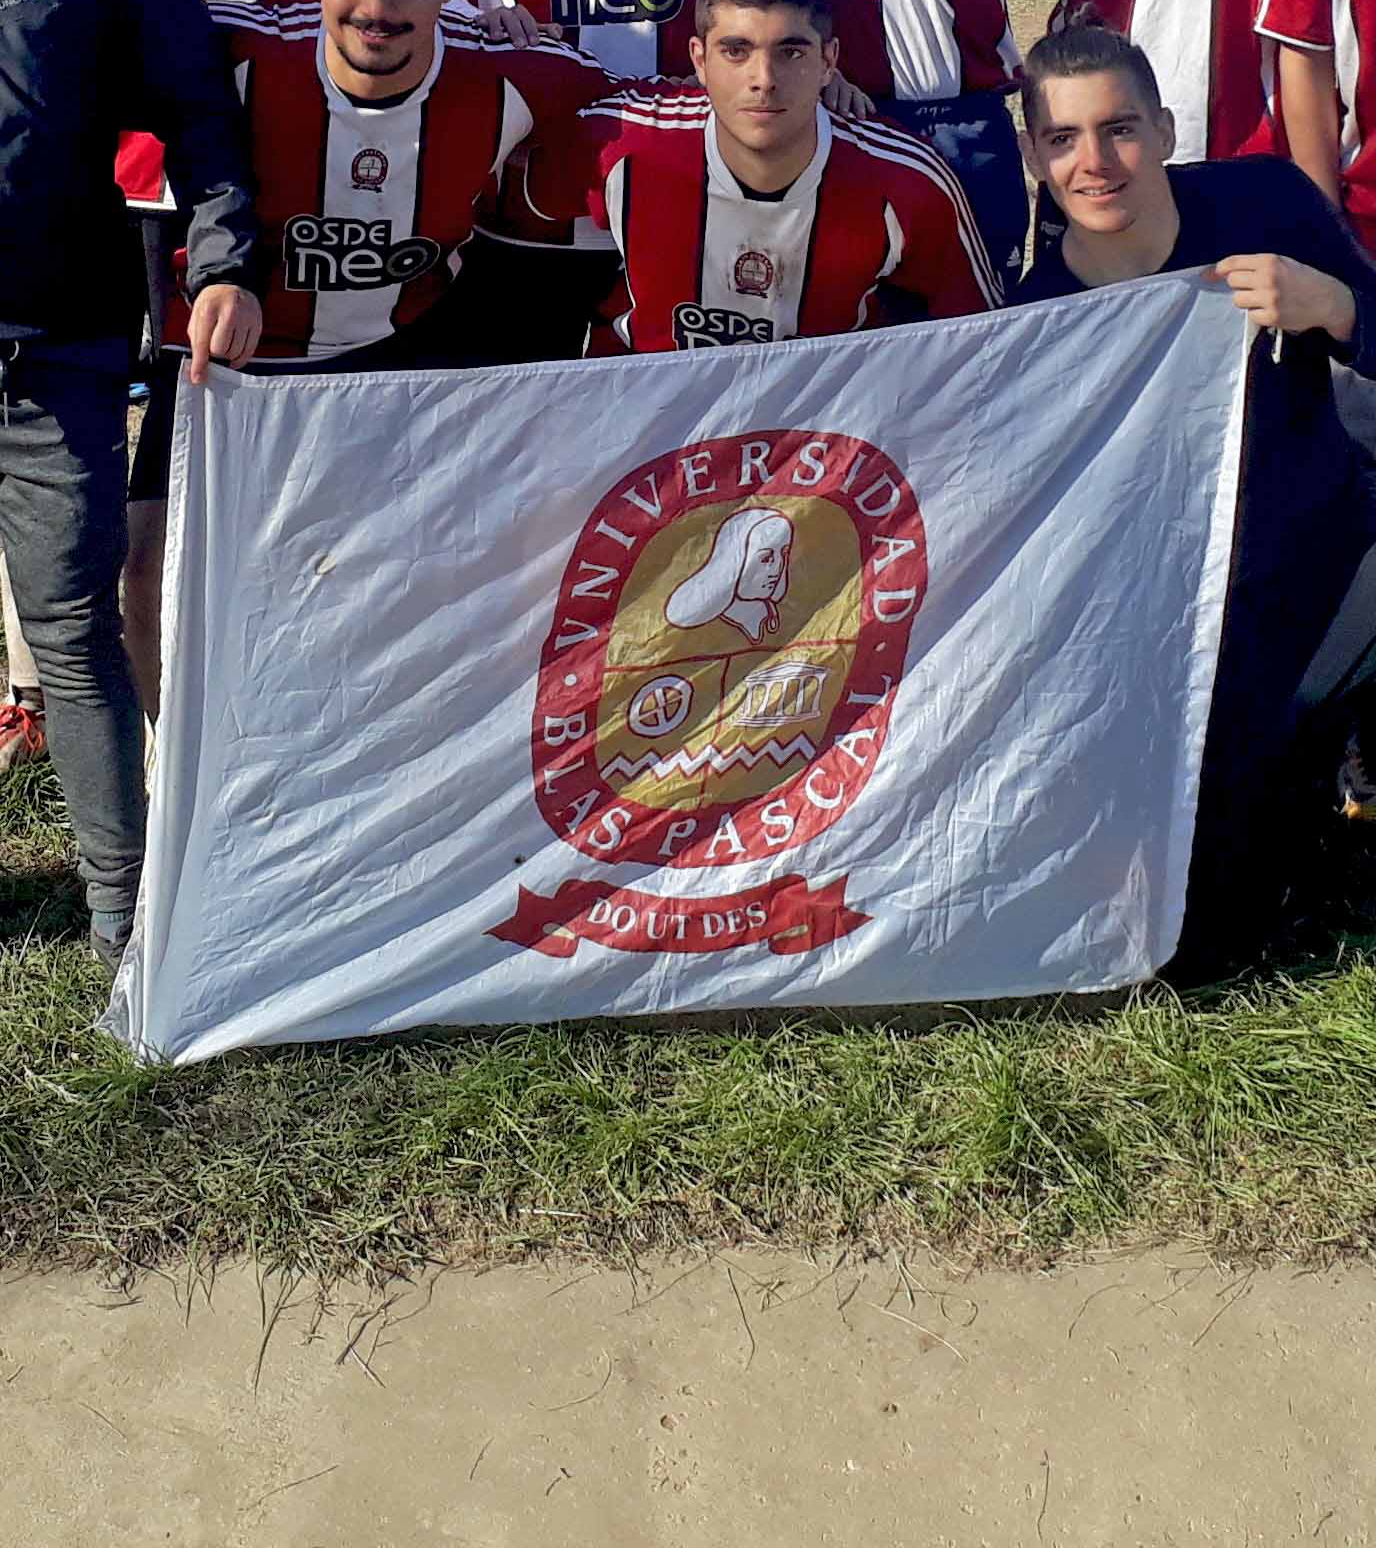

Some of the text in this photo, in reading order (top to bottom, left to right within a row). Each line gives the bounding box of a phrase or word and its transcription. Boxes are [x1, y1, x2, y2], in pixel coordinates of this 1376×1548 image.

[291, 219, 386, 246] OSDE
[295, 245, 428, 284] neo
[679, 307, 769, 343] OSDE
[542, 674, 892, 857] BLAS PASCAL
[586, 898, 769, 941] DO UT DES
